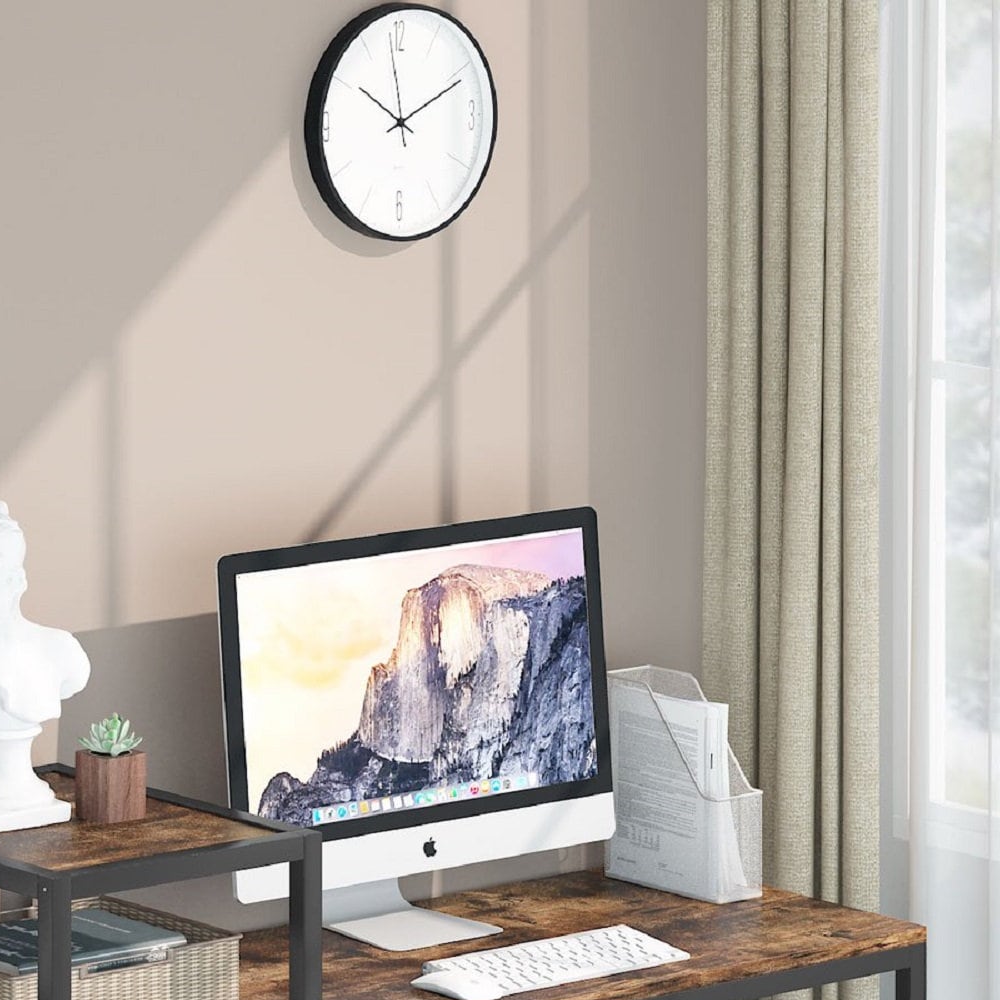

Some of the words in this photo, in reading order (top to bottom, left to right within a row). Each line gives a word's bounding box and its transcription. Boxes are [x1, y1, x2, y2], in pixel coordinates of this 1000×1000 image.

[393, 20, 405, 52] 12
[322, 111, 330, 142] 9
[468, 100, 475, 131] 3
[396, 190, 403, 222] 6
